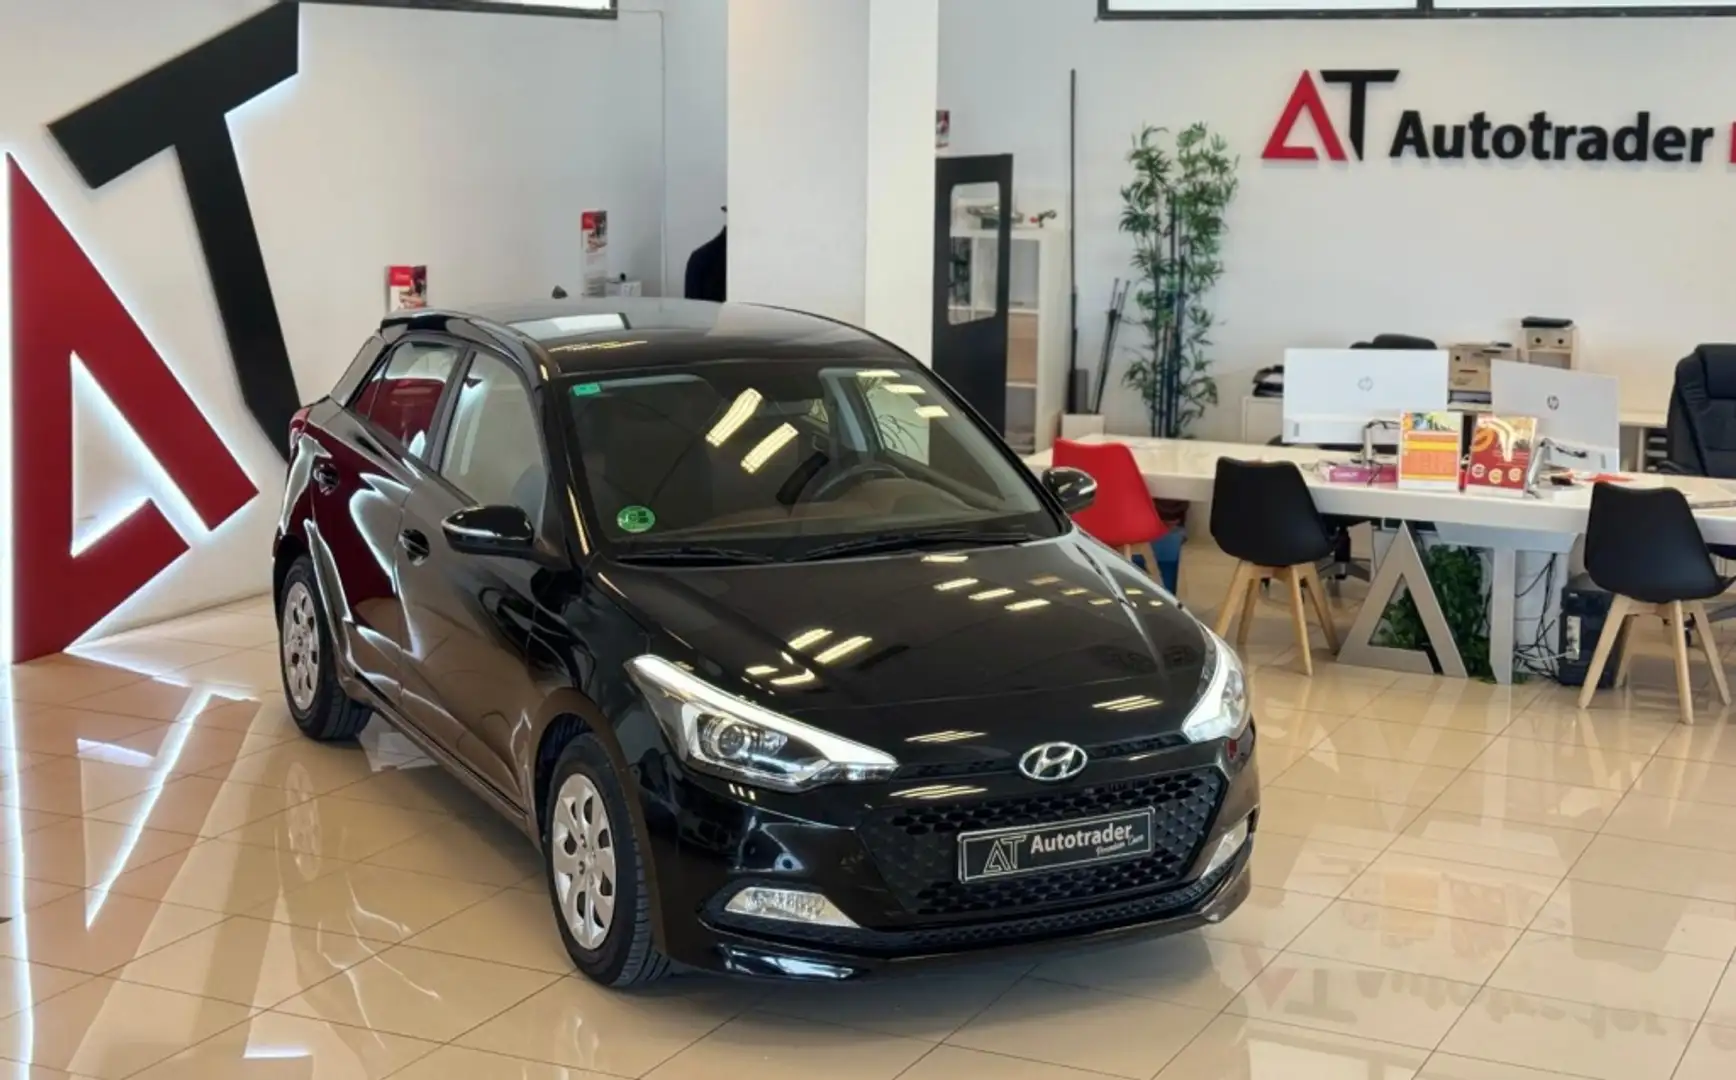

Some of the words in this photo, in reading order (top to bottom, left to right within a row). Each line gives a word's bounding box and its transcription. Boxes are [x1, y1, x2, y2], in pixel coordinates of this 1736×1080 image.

[1261, 69, 1400, 161] AT
[1389, 110, 1714, 162] Autotrader
[1030, 823, 1133, 854] Autotrader
